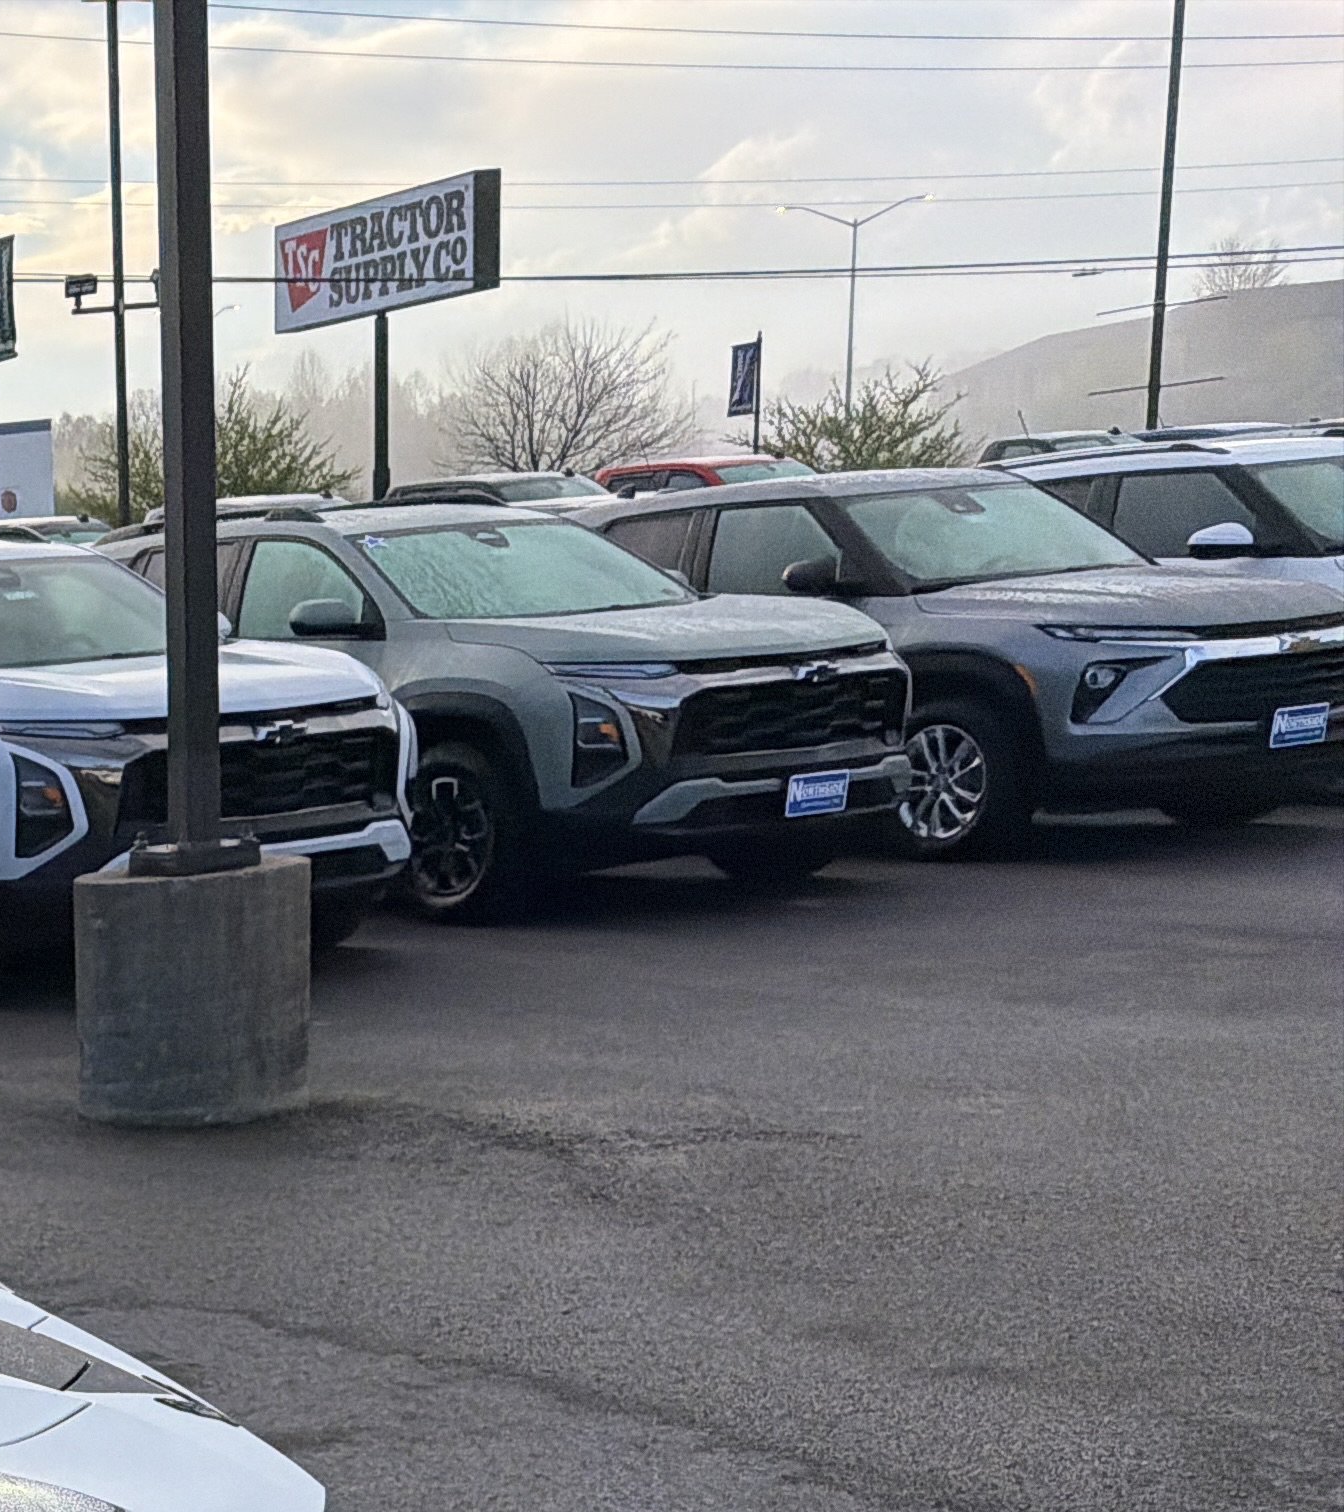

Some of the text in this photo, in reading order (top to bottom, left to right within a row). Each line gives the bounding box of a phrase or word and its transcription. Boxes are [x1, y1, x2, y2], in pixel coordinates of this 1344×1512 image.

[330, 189, 467, 263] TRACTOR
[284, 239, 320, 292] TSC
[329, 244, 431, 308] SUPPLY
